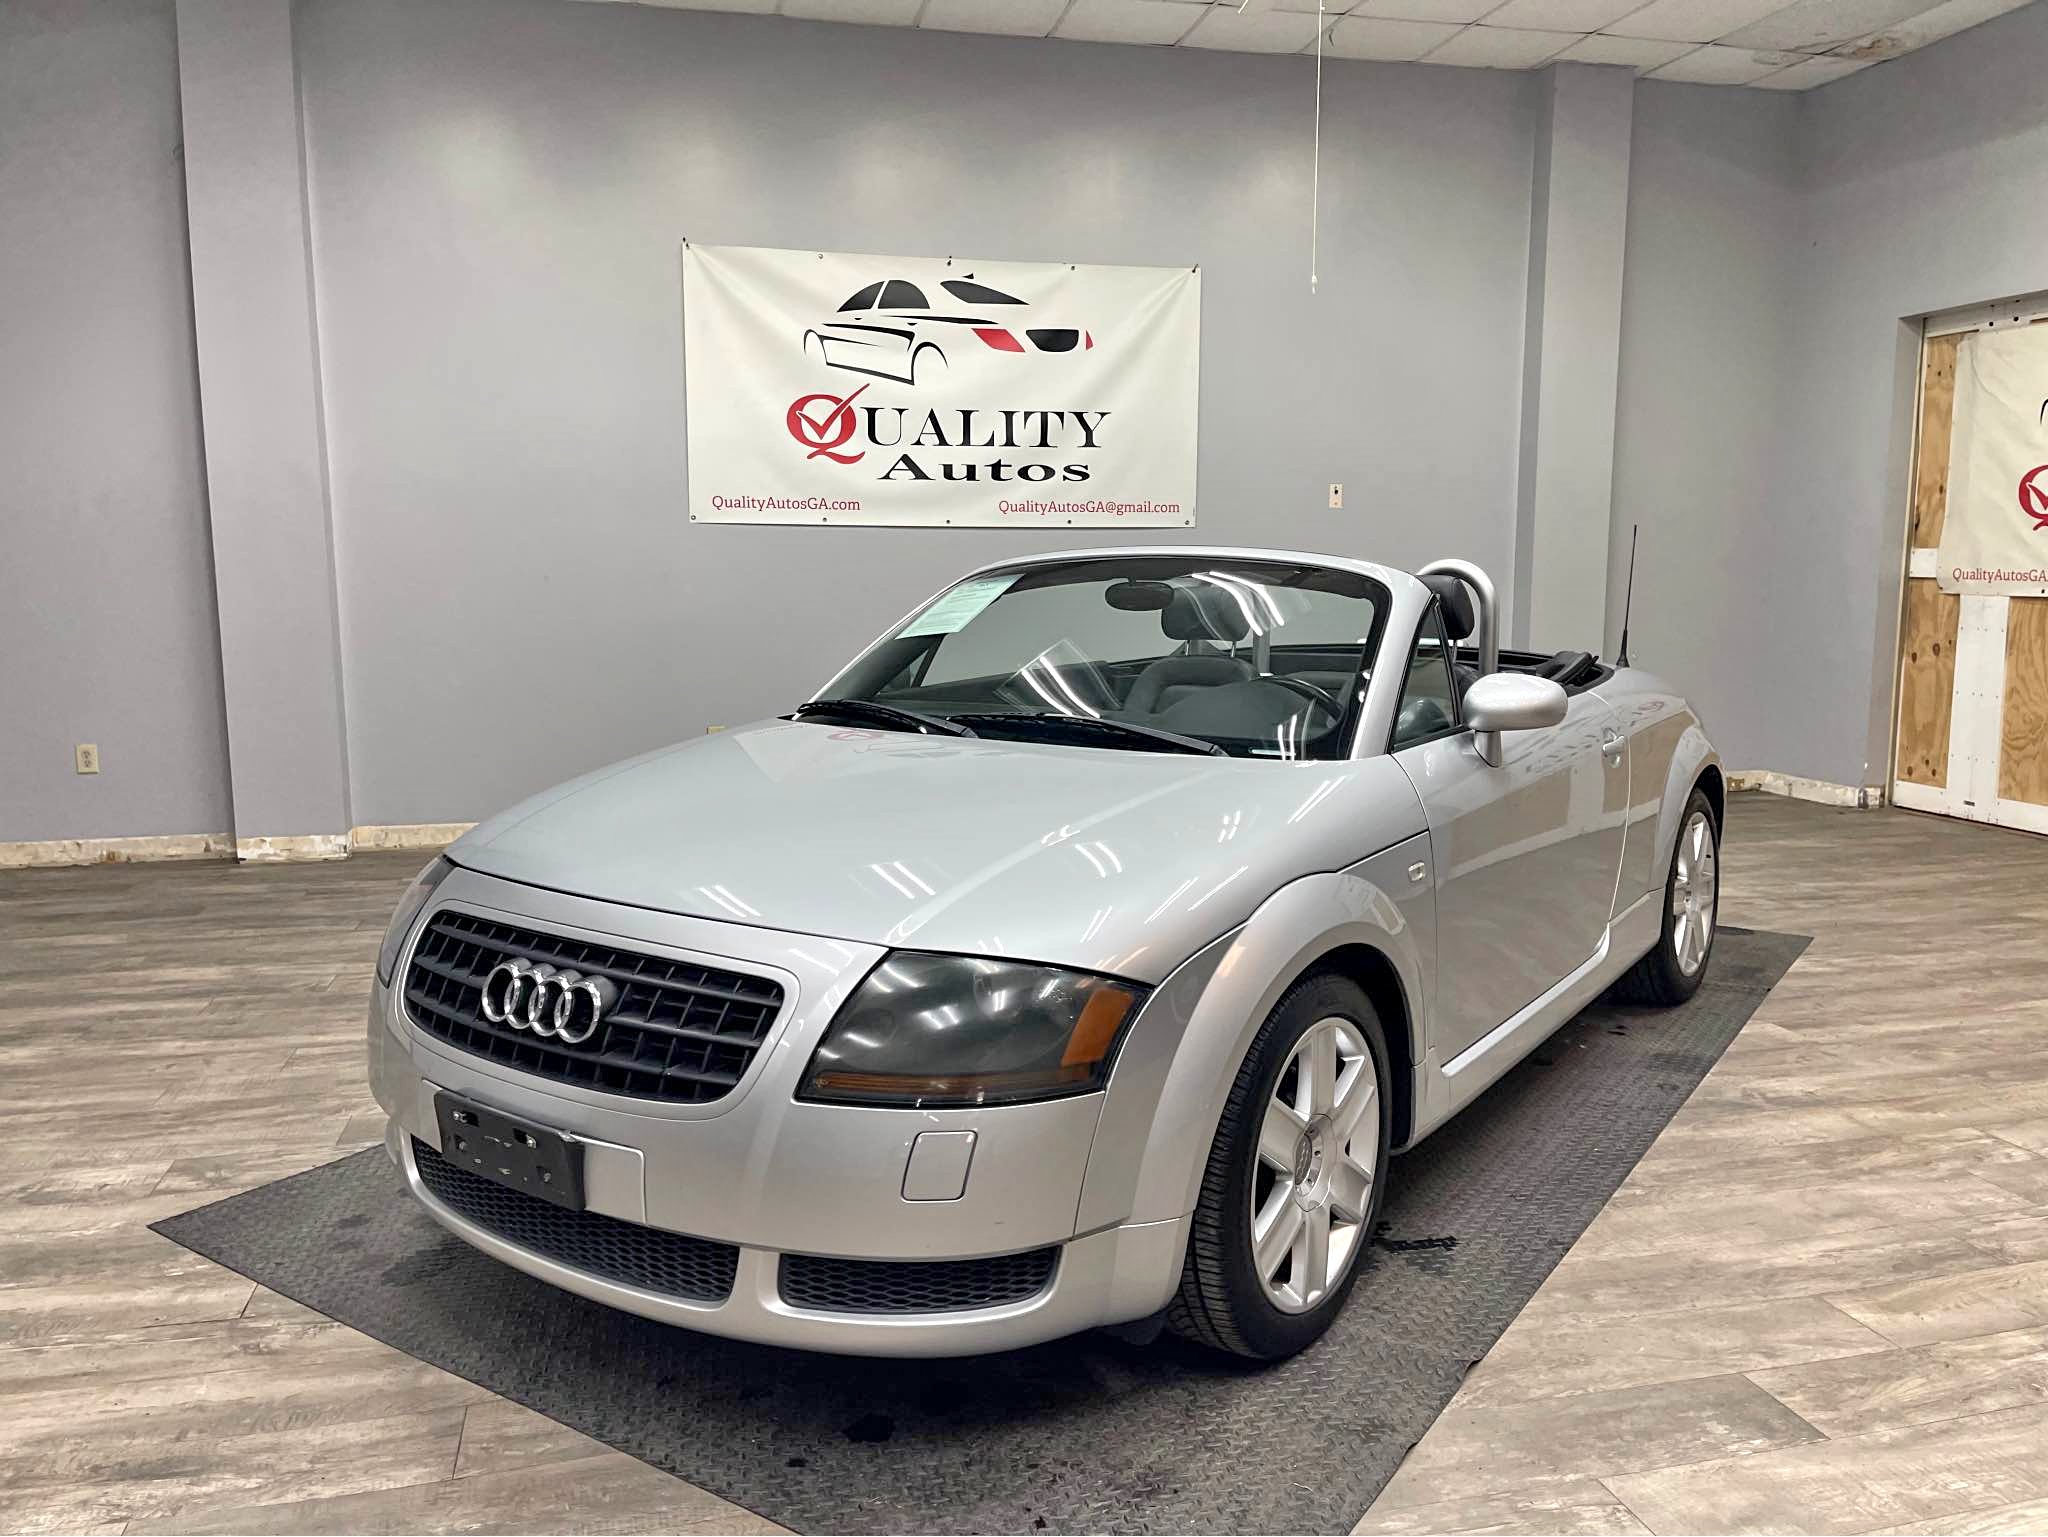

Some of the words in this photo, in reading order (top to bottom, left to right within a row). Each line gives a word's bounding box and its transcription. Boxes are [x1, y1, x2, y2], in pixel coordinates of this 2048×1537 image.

[787, 384, 1112, 465] QUALITY
[877, 453, 1091, 482] Autos
[712, 495, 861, 512] QualityAutosGA.com
[998, 500, 1180, 516] QualityAutosGA@gmail.com
